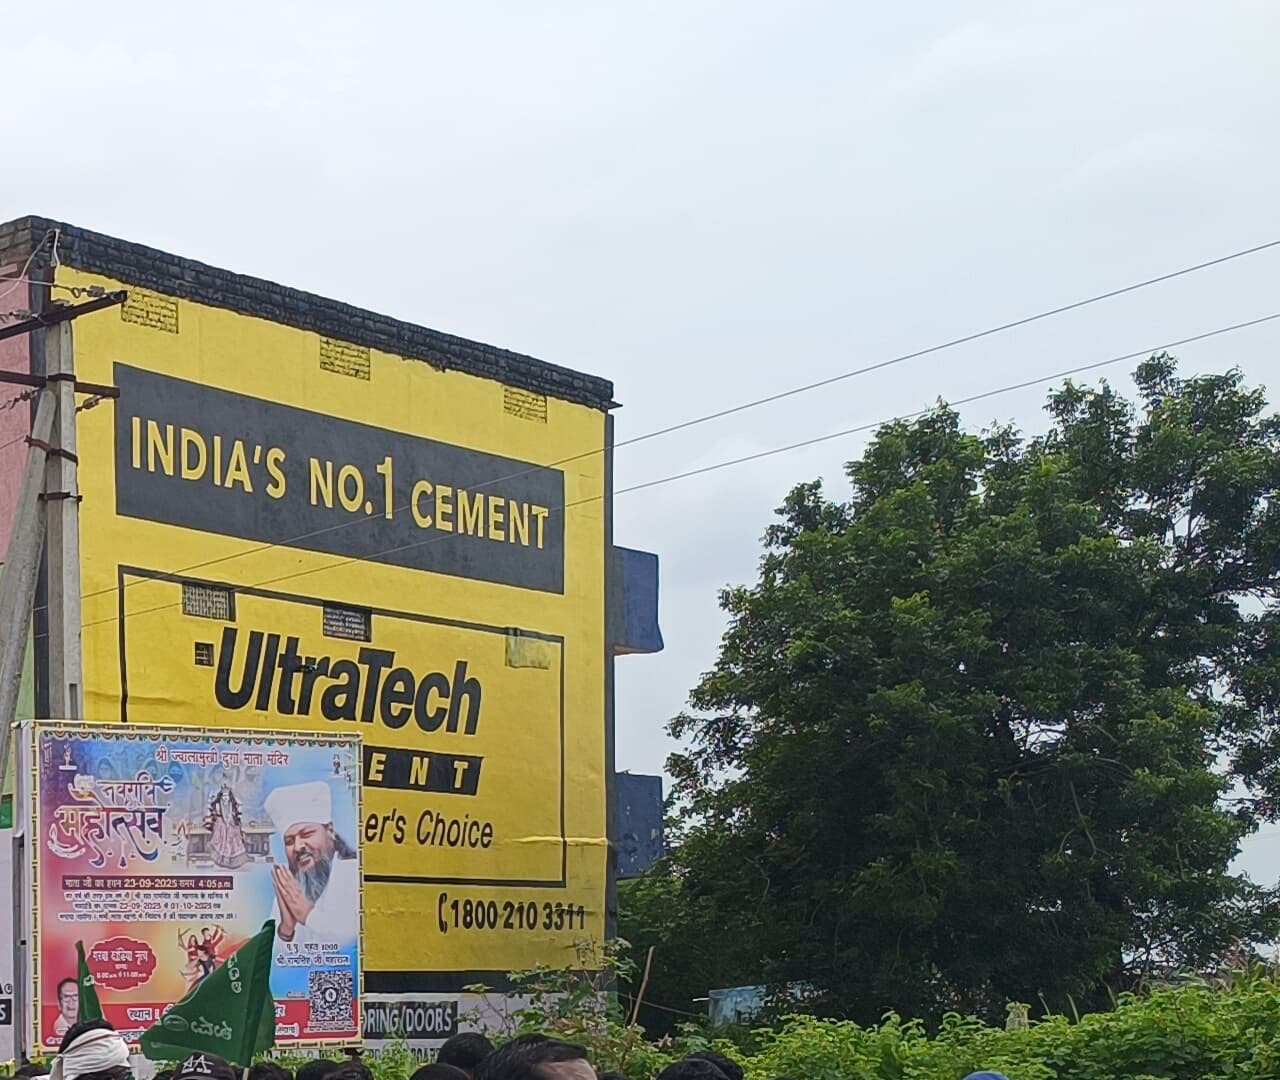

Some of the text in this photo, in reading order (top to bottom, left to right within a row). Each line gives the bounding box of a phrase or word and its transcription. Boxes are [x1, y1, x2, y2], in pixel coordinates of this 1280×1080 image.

[132, 416, 286, 499] INDIA'S
[411, 479, 550, 550] CEMENT
[215, 627, 482, 735] UltraTech
[156, 745, 167, 762] श्री
[416, 809, 493, 849] Choice
[451, 898, 498, 929] 1800
[502, 901, 538, 931] 210
